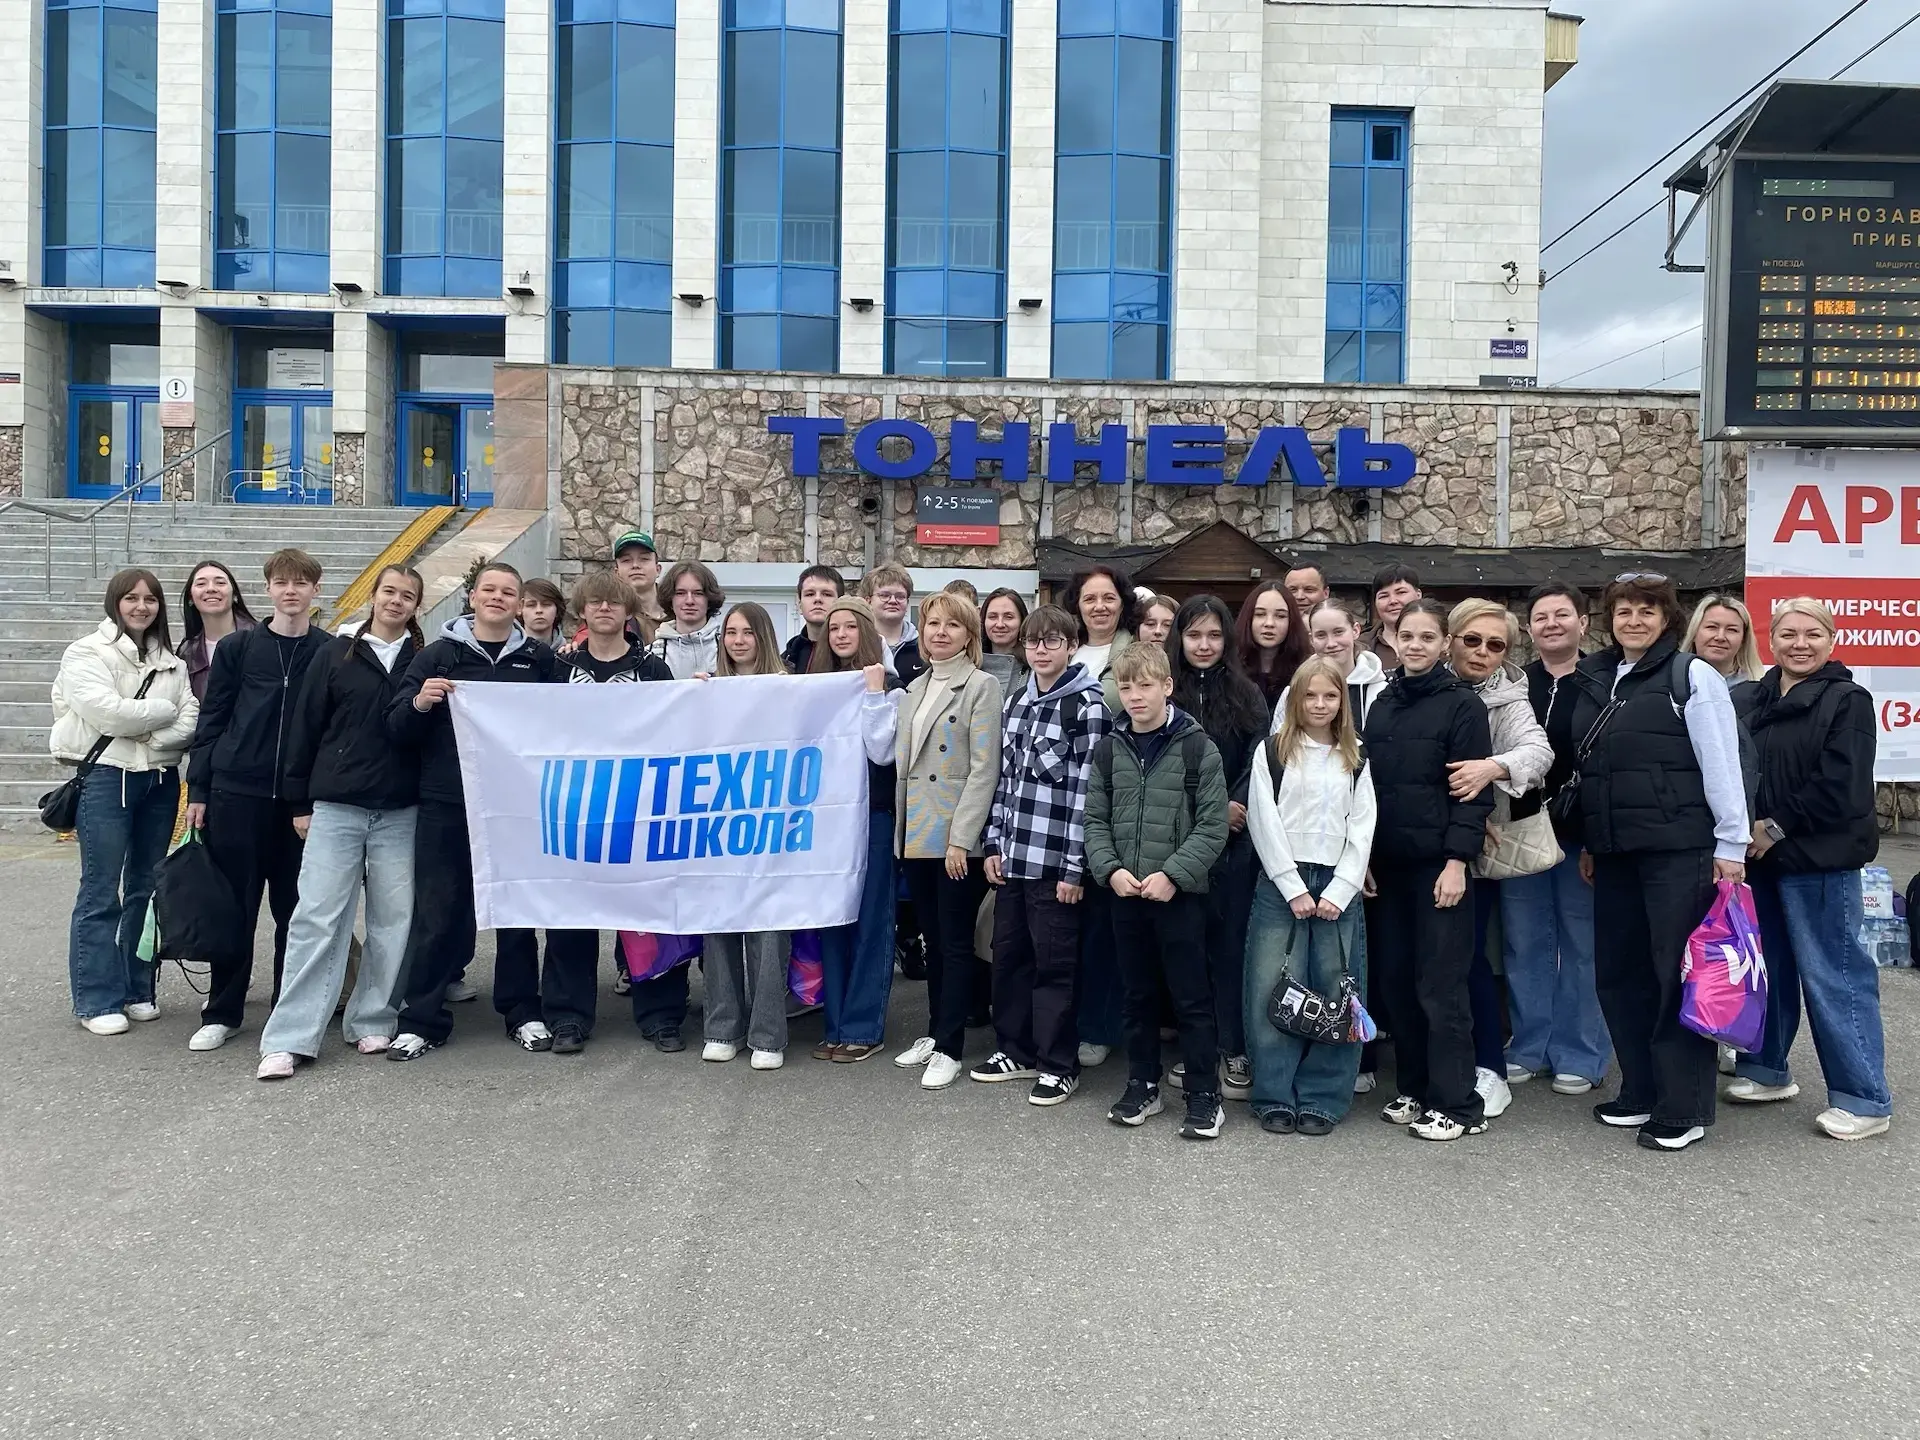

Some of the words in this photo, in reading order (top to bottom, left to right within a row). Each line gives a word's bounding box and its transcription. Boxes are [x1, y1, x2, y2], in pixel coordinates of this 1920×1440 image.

[1785, 206, 1920, 224] ГОРНОЗАВ
[1853, 232, 1920, 247] ПРИБ
[1773, 260, 1805, 268] ПОЕЗДА
[1875, 261, 1912, 269] МАРШРУТ
[1515, 344, 1527, 354] 89
[768, 416, 1416, 488] ТОННЕЛЬ
[934, 495, 958, 510] 2-5
[967, 497, 993, 505] поездам
[1771, 598, 1920, 617] КМЕРЧЕС
[648, 746, 823, 817] ТЕХНО
